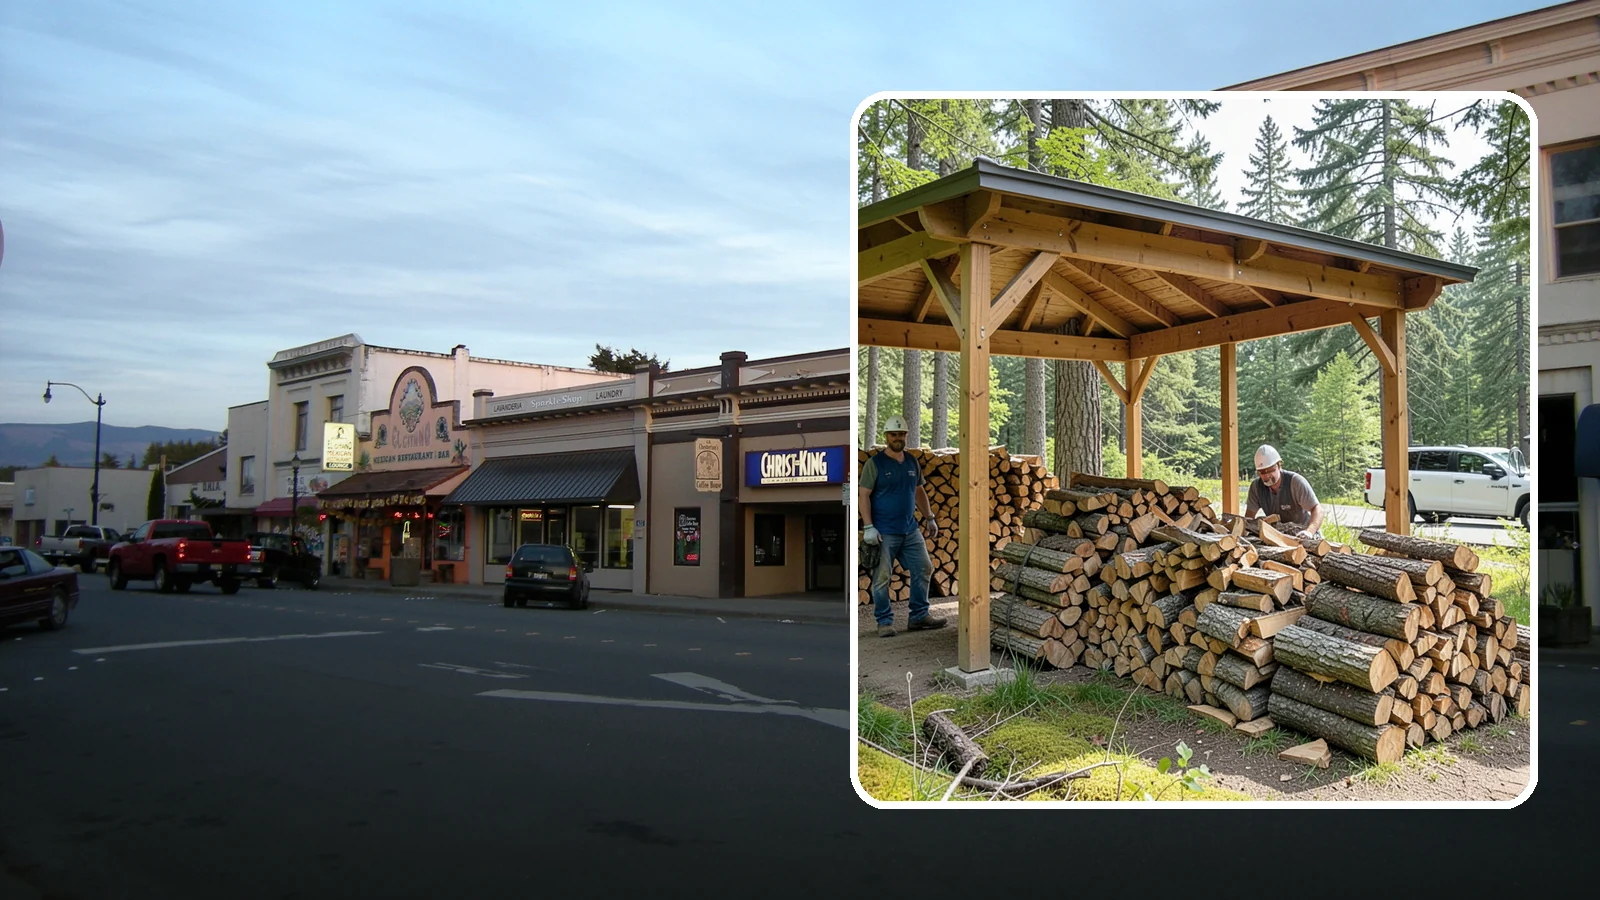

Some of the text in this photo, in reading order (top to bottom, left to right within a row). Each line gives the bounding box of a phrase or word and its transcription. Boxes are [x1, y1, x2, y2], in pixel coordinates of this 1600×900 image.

[493, 389, 623, 413] LAVANDERIA Sparkle Shop LAUNDRY
[373, 450, 450, 464] MEXICAN RESTAURANT BAR
[761, 450, 827, 478] CHRIST KING
